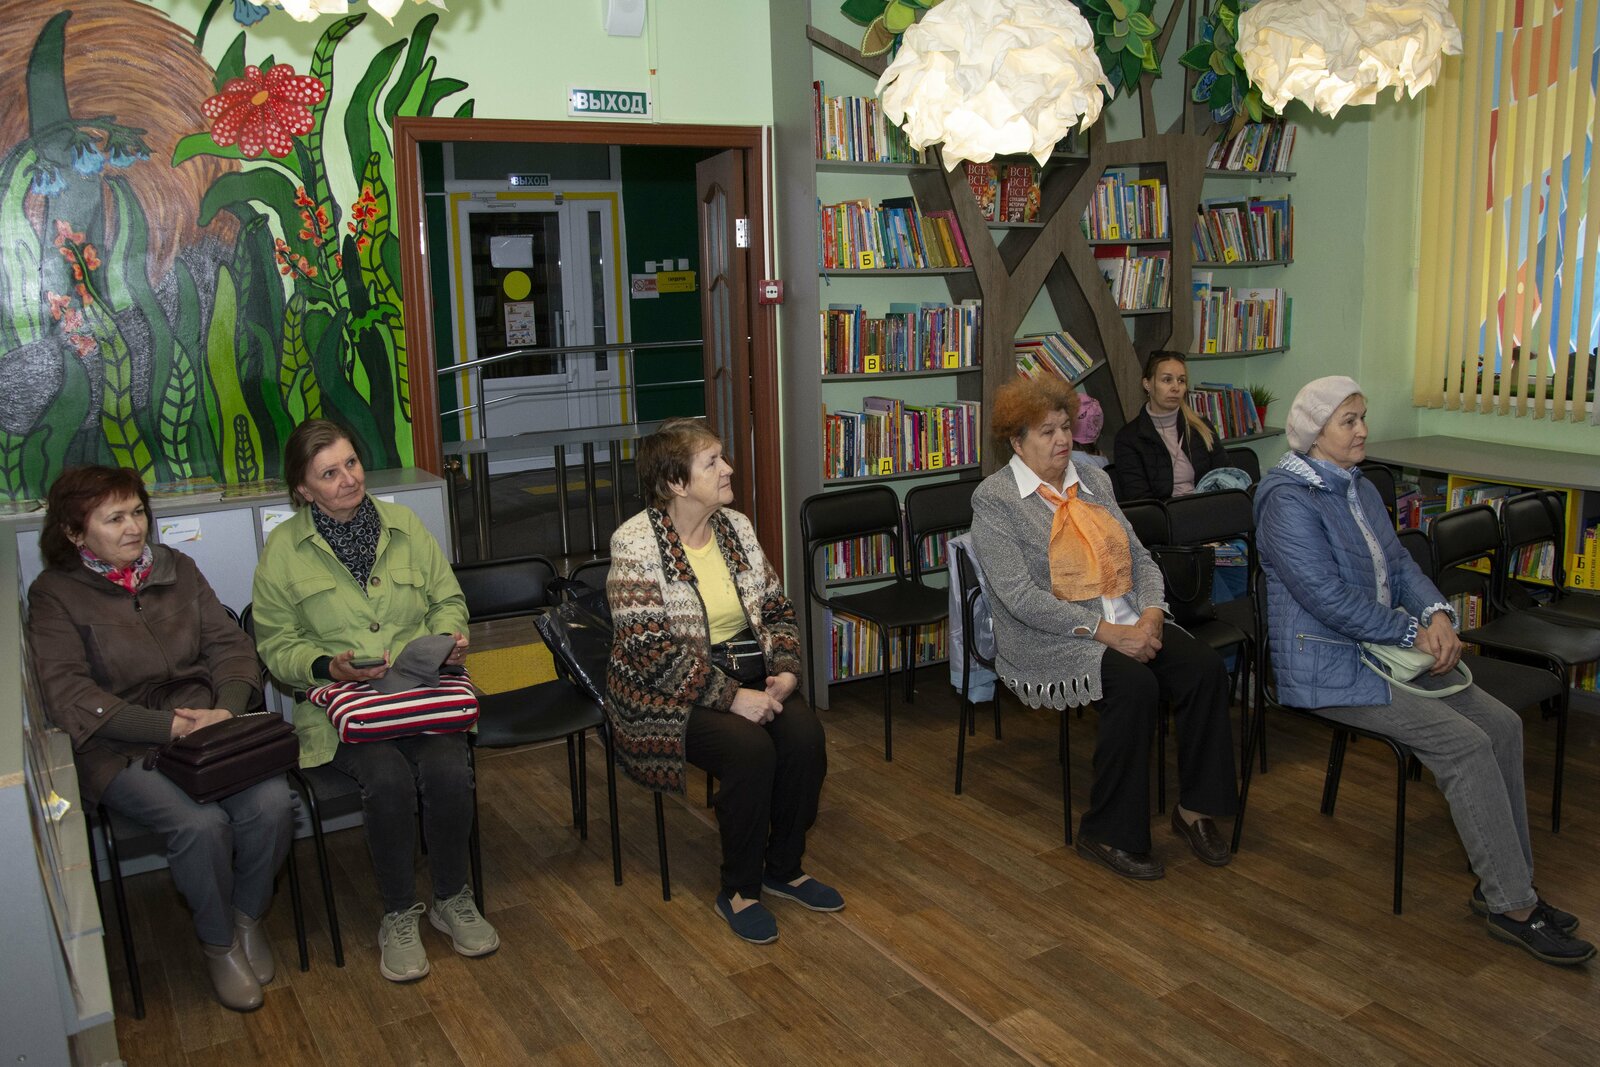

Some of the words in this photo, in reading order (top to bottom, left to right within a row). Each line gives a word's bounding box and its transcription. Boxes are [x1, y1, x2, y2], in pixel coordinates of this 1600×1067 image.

[576, 92, 644, 113] ВЫХОД
[512, 176, 547, 186] ВЫХОД
[863, 255, 871, 265] Б
[868, 358, 877, 370] В
[947, 354, 955, 365] Г
[932, 454, 940, 466] Е
[881, 460, 892, 474] Д
